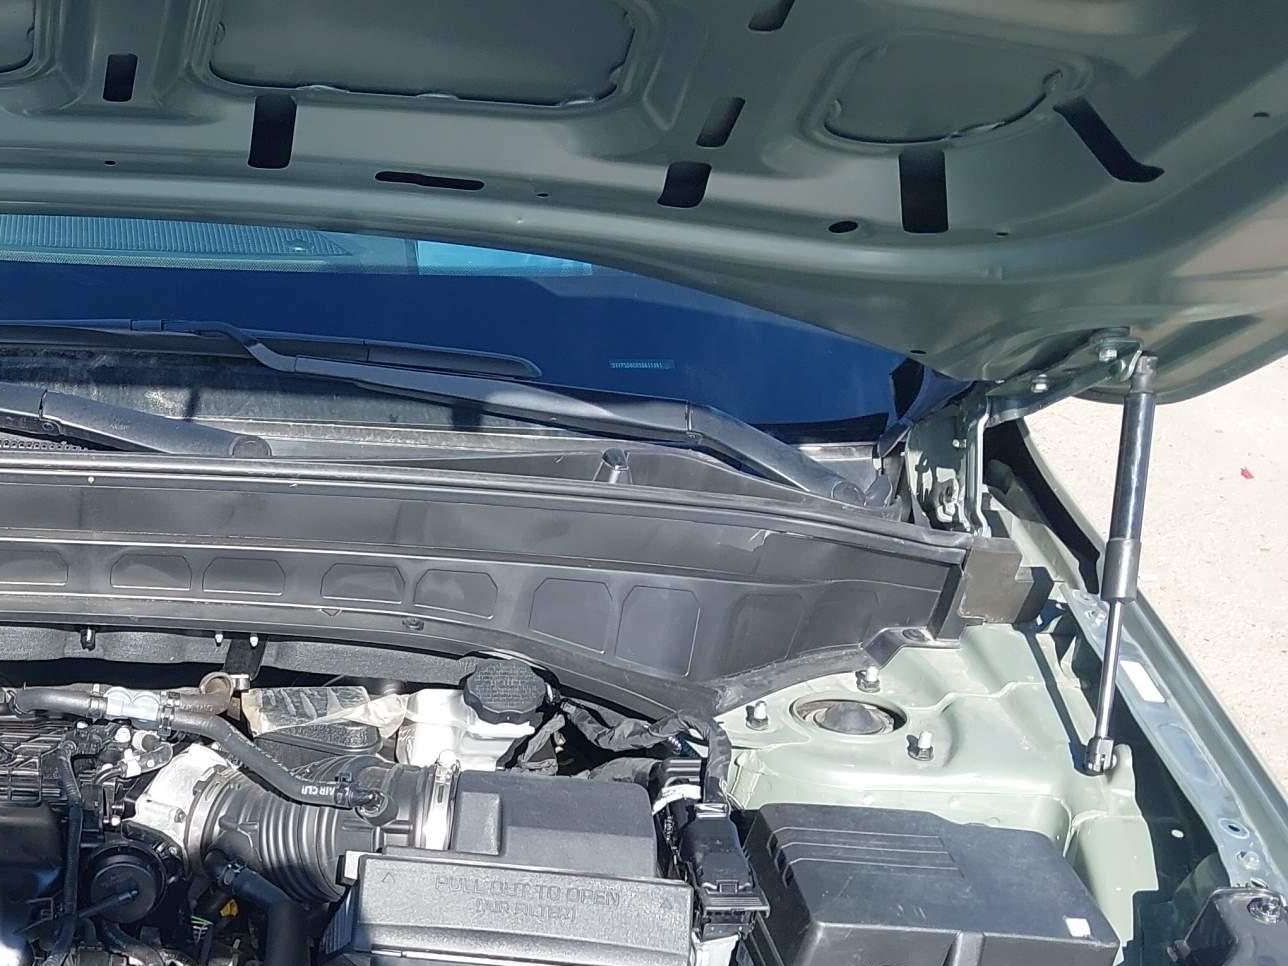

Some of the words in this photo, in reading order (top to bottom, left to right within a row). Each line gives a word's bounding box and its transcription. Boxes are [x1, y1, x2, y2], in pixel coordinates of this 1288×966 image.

[435, 875, 483, 894] PULL
[490, 880, 528, 899] OUT
[535, 884, 562, 901] TO
[566, 887, 620, 907] OPEN
